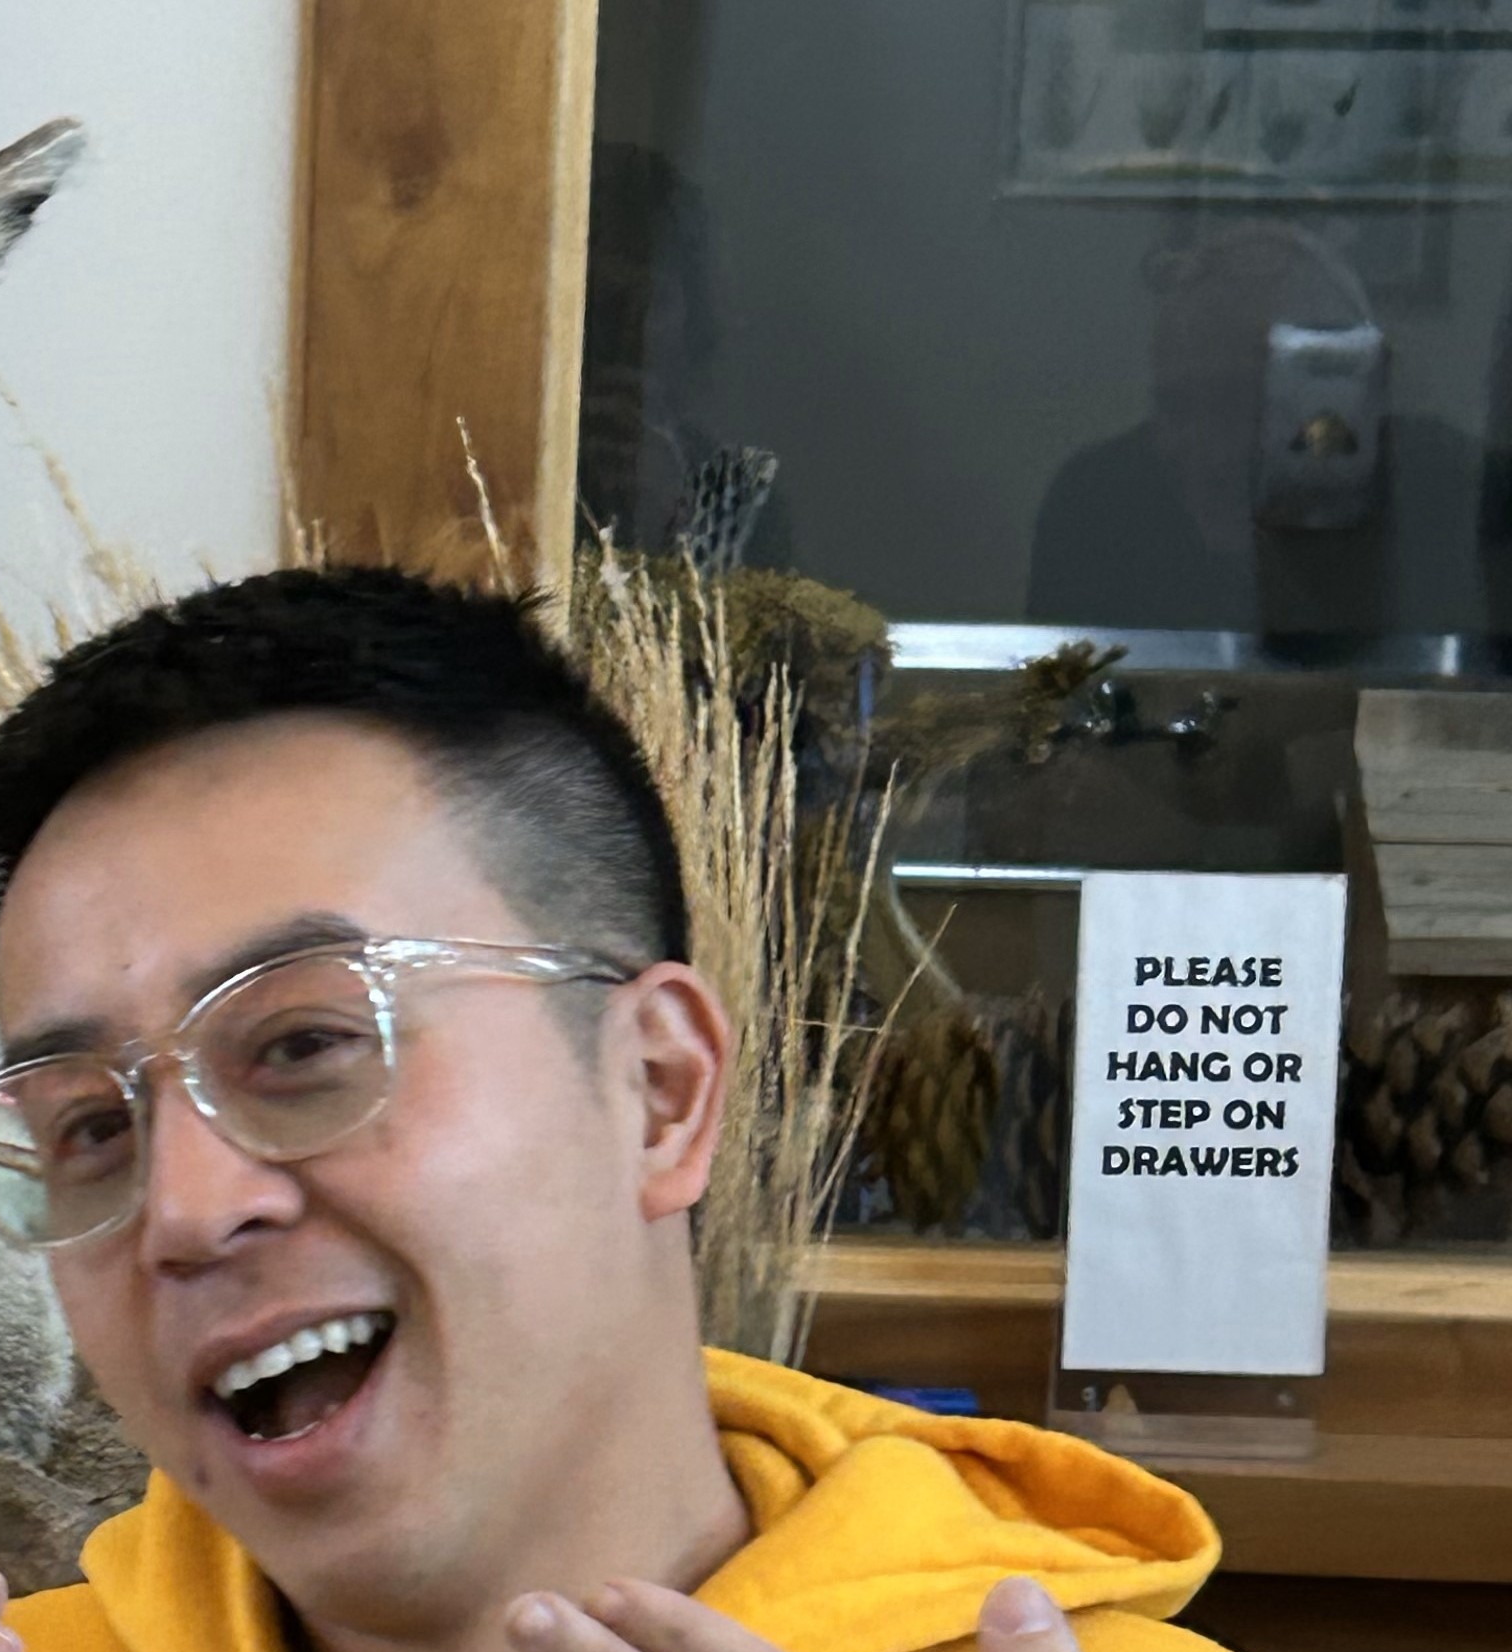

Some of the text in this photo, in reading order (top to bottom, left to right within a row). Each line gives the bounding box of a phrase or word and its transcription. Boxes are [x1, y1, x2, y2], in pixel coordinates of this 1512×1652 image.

[1135, 957, 1283, 987] PLEASE
[1127, 1005, 1288, 1035] DO NOT
[1107, 1052, 1302, 1083] HANG OR
[1118, 1098, 1285, 1130] STEP ON
[1102, 1146, 1300, 1178] DRAWERS
